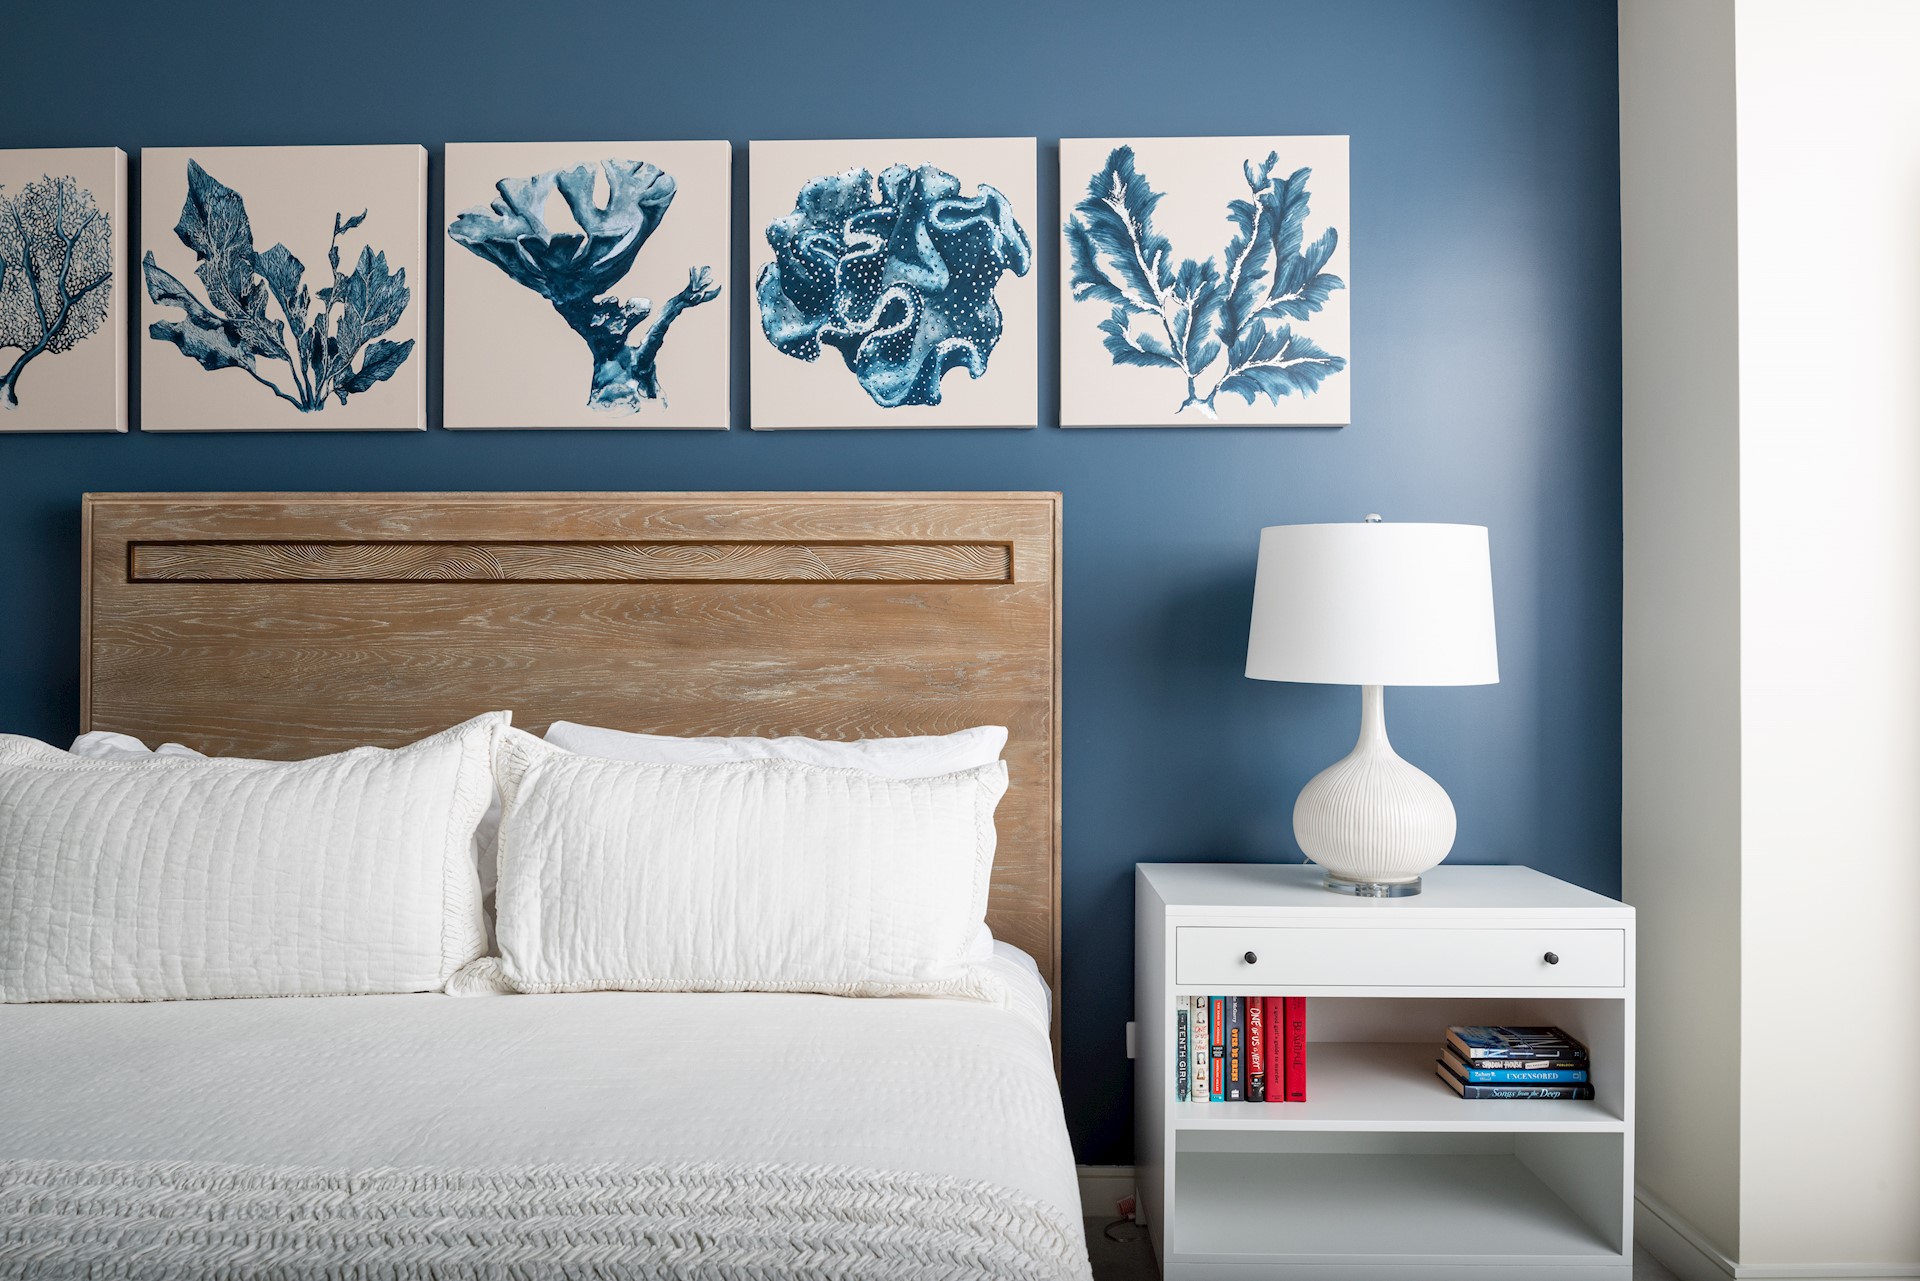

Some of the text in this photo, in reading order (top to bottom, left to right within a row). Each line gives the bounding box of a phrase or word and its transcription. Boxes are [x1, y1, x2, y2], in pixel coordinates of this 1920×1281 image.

[1250, 1008, 1261, 1027] ONE
[1252, 1027, 1260, 1035] OF
[1251, 1035, 1260, 1047] US
[1250, 1052, 1261, 1070] NEXT
[1504, 1060, 1523, 1069] HOUSE
[1506, 1072, 1559, 1080] UNCENSORED
[1492, 1088, 1561, 1099] Songs from the Deep
